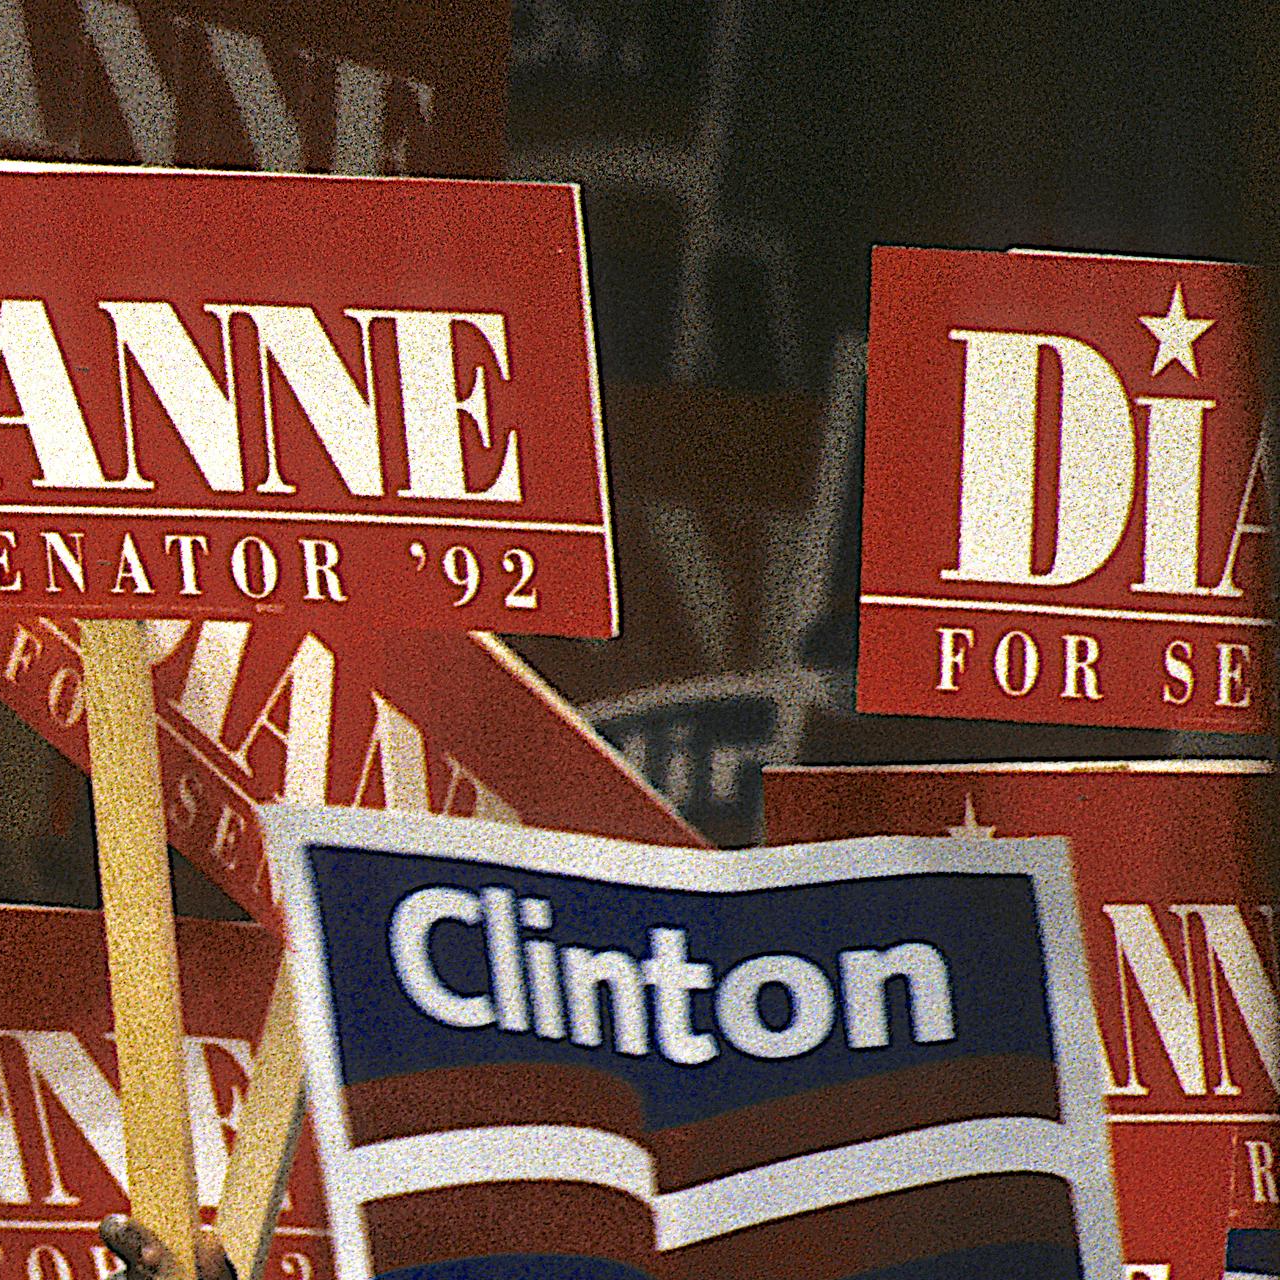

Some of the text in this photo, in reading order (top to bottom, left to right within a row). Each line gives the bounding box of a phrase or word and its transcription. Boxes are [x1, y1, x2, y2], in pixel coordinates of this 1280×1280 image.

[408, 541, 539, 609] '92
[936, 627, 1103, 702] FOR
[387, 884, 957, 1067] Clinton
